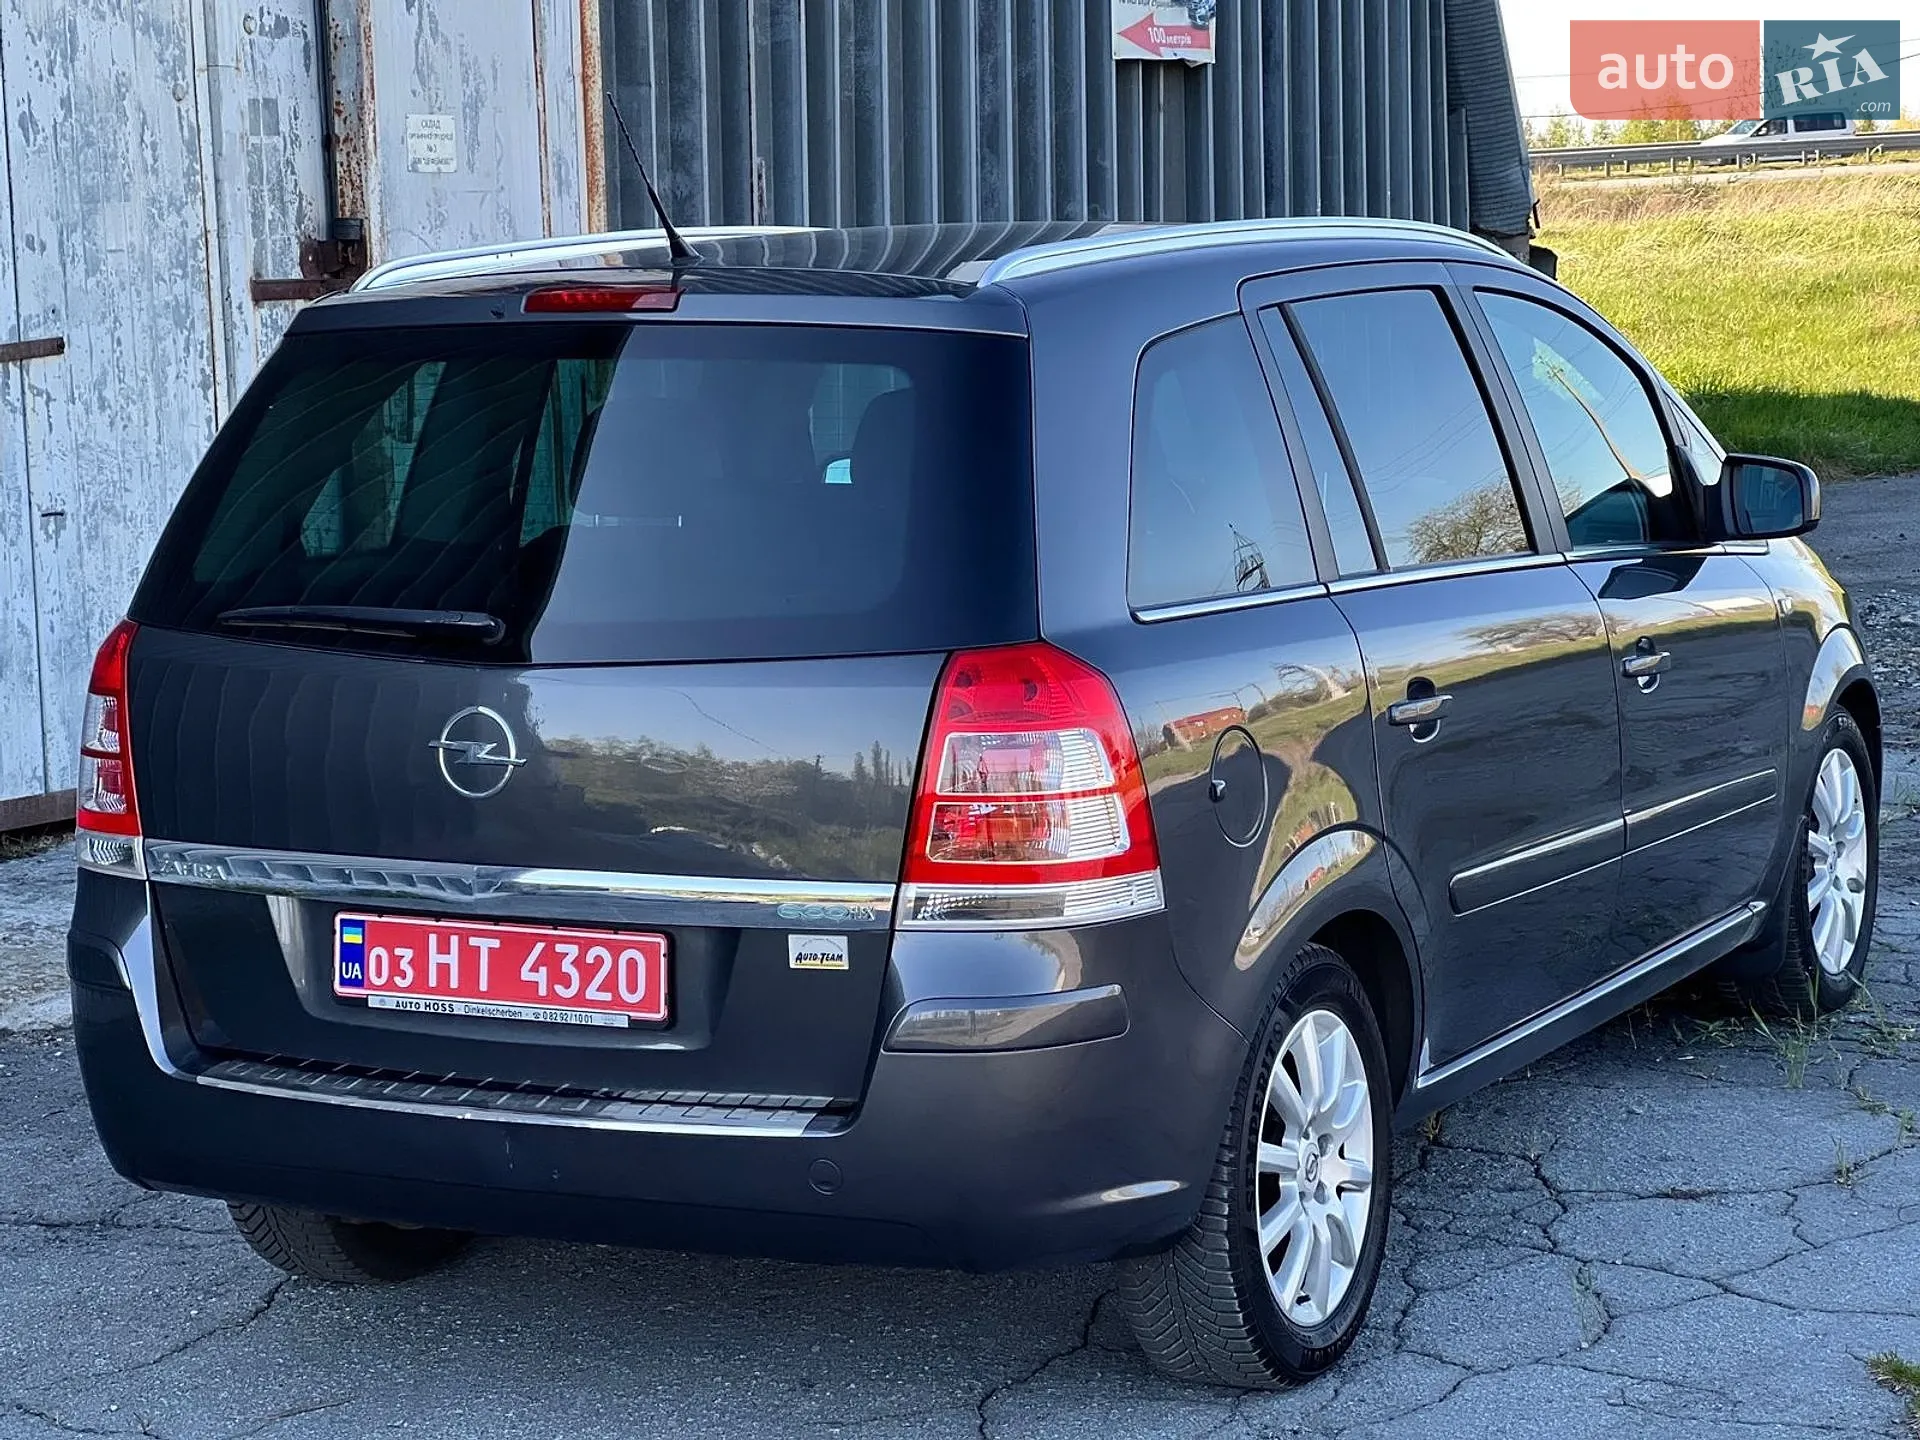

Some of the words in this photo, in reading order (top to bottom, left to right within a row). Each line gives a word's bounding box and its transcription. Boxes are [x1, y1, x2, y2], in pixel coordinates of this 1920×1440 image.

[1147, 26, 1166, 44] 100
[342, 961, 363, 980] UA
[368, 946, 414, 988] 03
[520, 941, 647, 1004] 4320
[395, 1000, 421, 1011] AUTO
